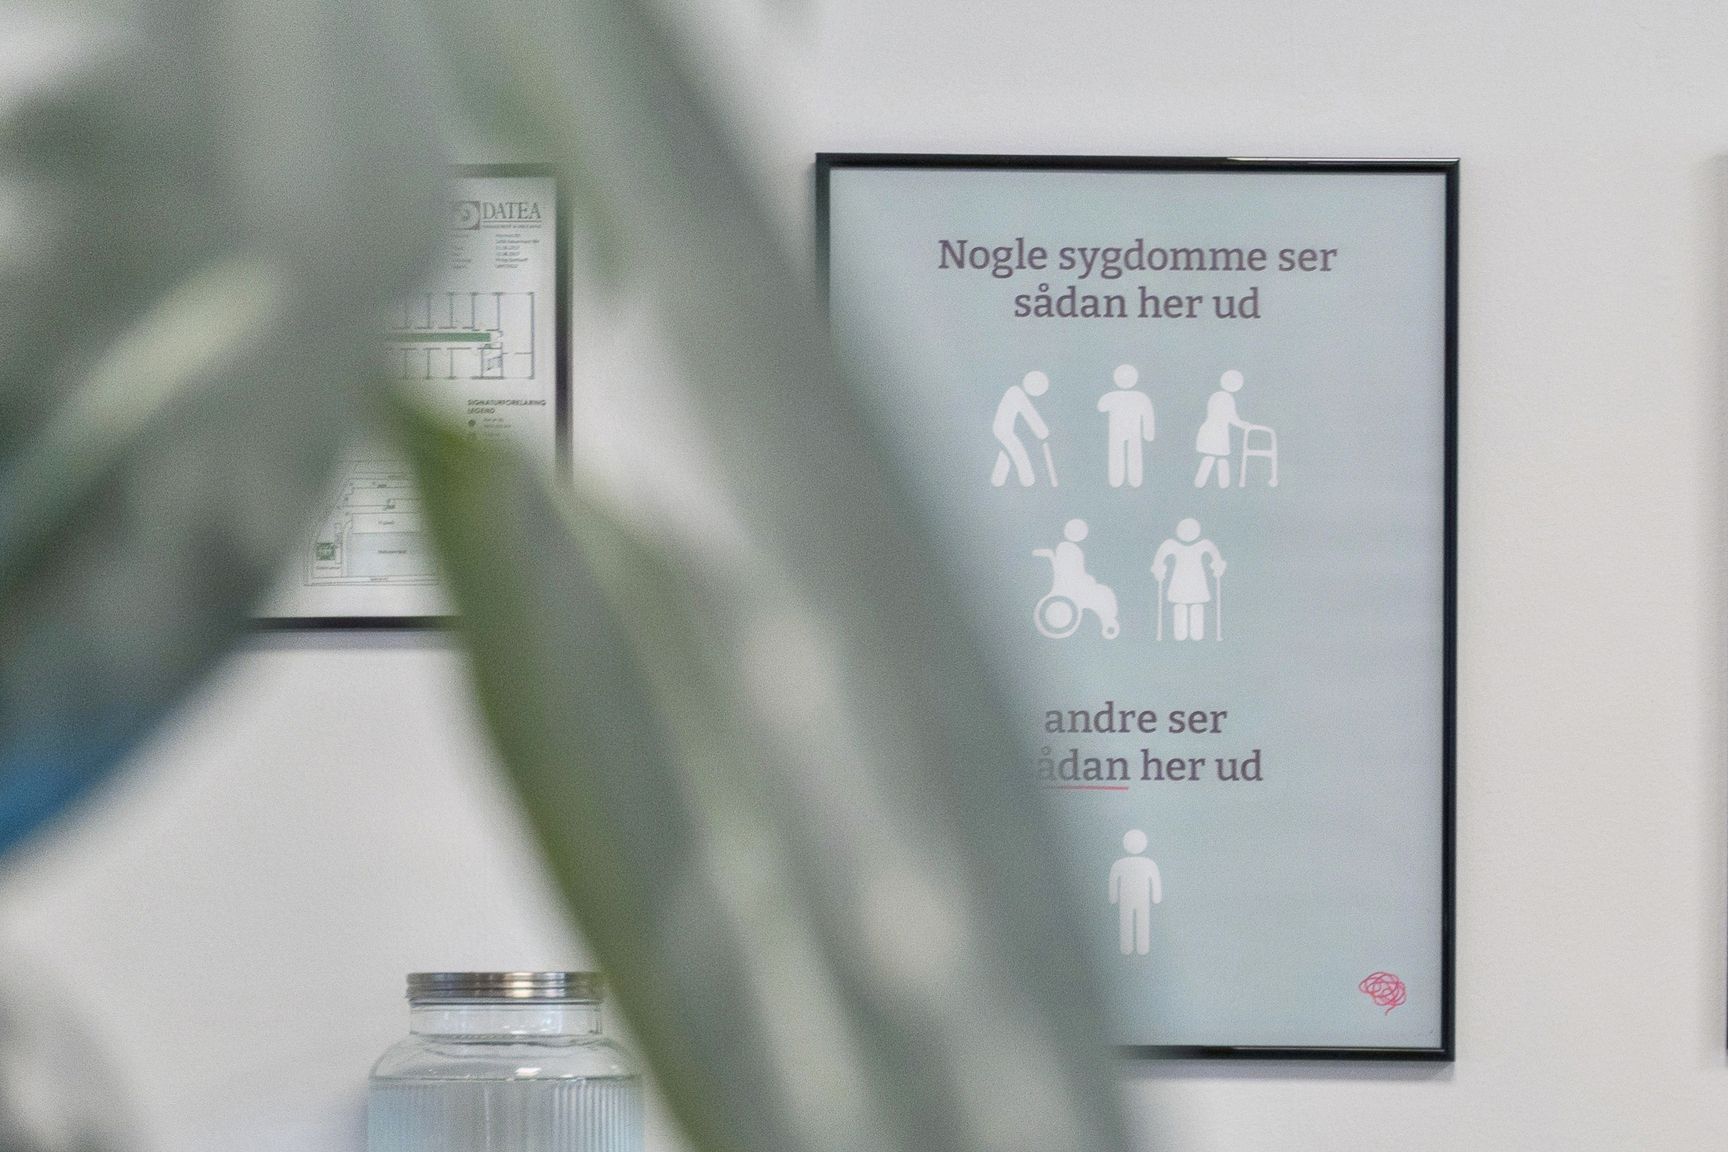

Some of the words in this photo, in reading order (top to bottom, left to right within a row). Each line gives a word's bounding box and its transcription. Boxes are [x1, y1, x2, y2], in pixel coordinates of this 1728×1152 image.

[482, 202, 541, 219] DATEA
[938, 236, 1048, 278] Nogle
[1058, 237, 1268, 278] sygdomme
[1278, 247, 1338, 273] ser
[1014, 282, 1128, 320] sådan
[1138, 285, 1203, 320] her
[1212, 286, 1262, 320] ud
[1044, 700, 1158, 734] andre
[1168, 709, 1229, 735] ser
[1034, 747, 1131, 782] ådan
[1139, 748, 1206, 782] her
[1215, 749, 1264, 782] ud
